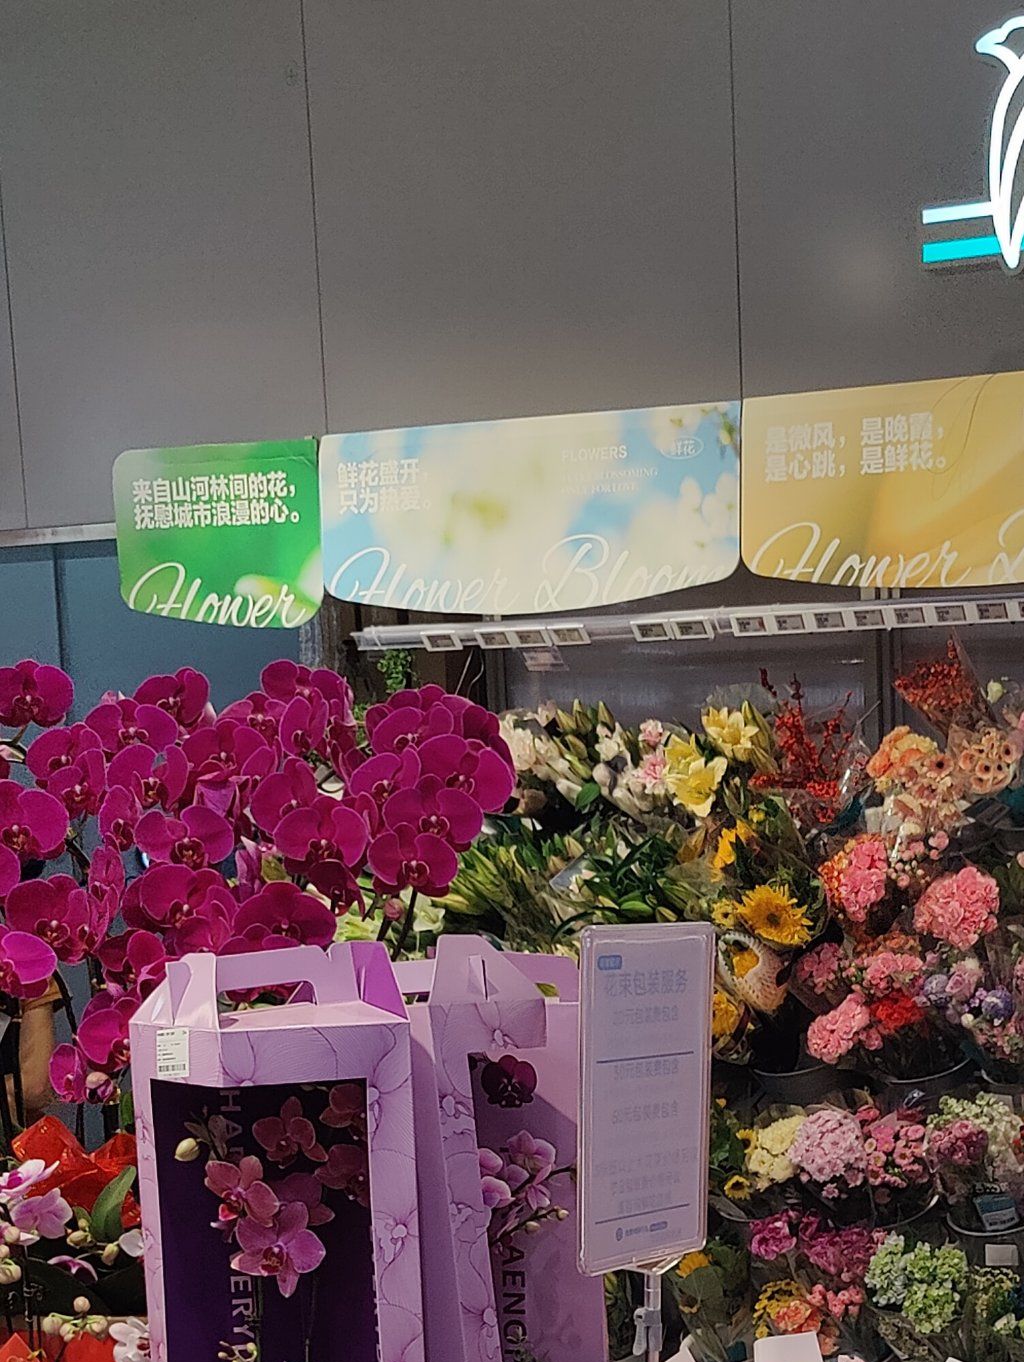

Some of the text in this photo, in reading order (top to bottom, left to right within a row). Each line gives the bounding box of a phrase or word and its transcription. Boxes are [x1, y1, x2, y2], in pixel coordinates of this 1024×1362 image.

[561, 445, 628, 463] FLOWERS
[132, 471, 297, 503] 来自山河林间的花，
[133, 498, 300, 529] 抚慰城市浪漫的心。
[128, 561, 306, 628] Flower
